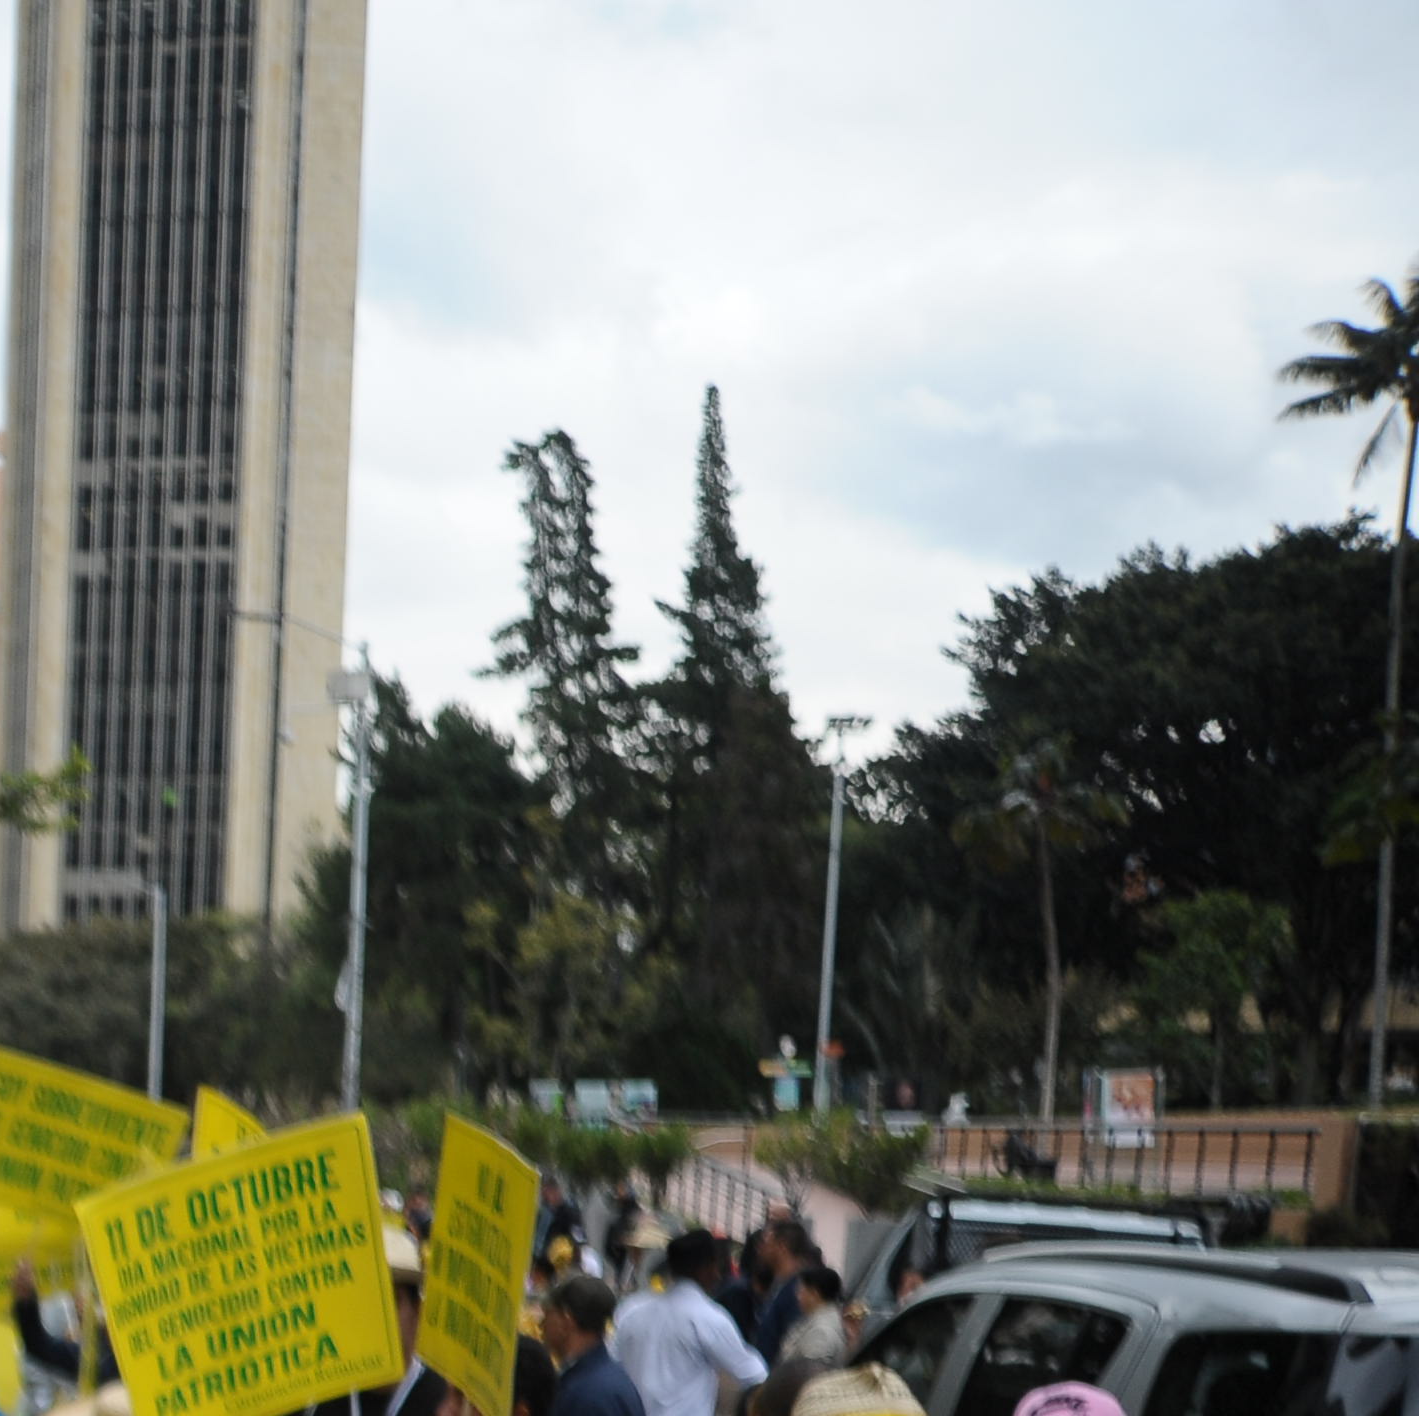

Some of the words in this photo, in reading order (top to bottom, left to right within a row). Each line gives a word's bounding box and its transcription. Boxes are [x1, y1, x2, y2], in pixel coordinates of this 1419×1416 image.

[135, 1199, 175, 1249] DE
[186, 1149, 341, 1230] OCTUBRE
[150, 1224, 254, 1277] NACIONAL
[266, 1258, 354, 1303] CONTRA
